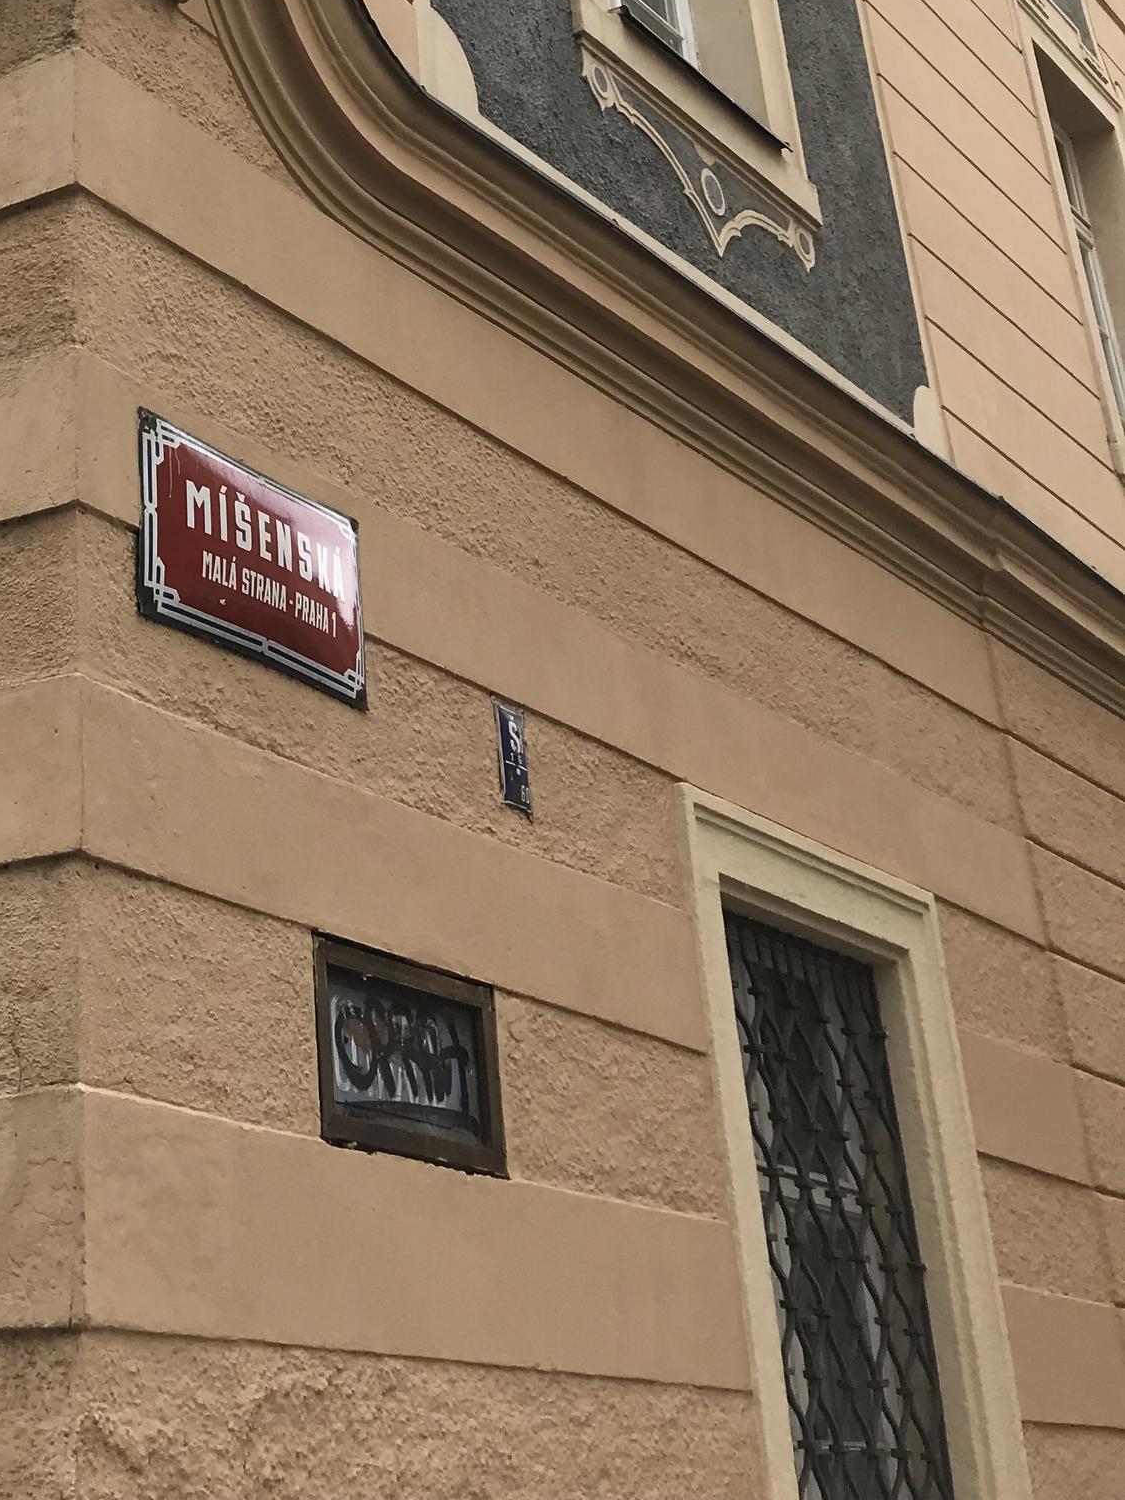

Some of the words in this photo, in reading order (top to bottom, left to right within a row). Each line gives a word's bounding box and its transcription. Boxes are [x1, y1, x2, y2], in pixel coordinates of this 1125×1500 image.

[186, 479, 344, 602] MÍŠENSKÁ
[202, 550, 237, 591] MALÁ
[241, 568, 287, 613] STRANA
[294, 592, 329, 634] PRAHA
[331, 612, 337, 637] 1
